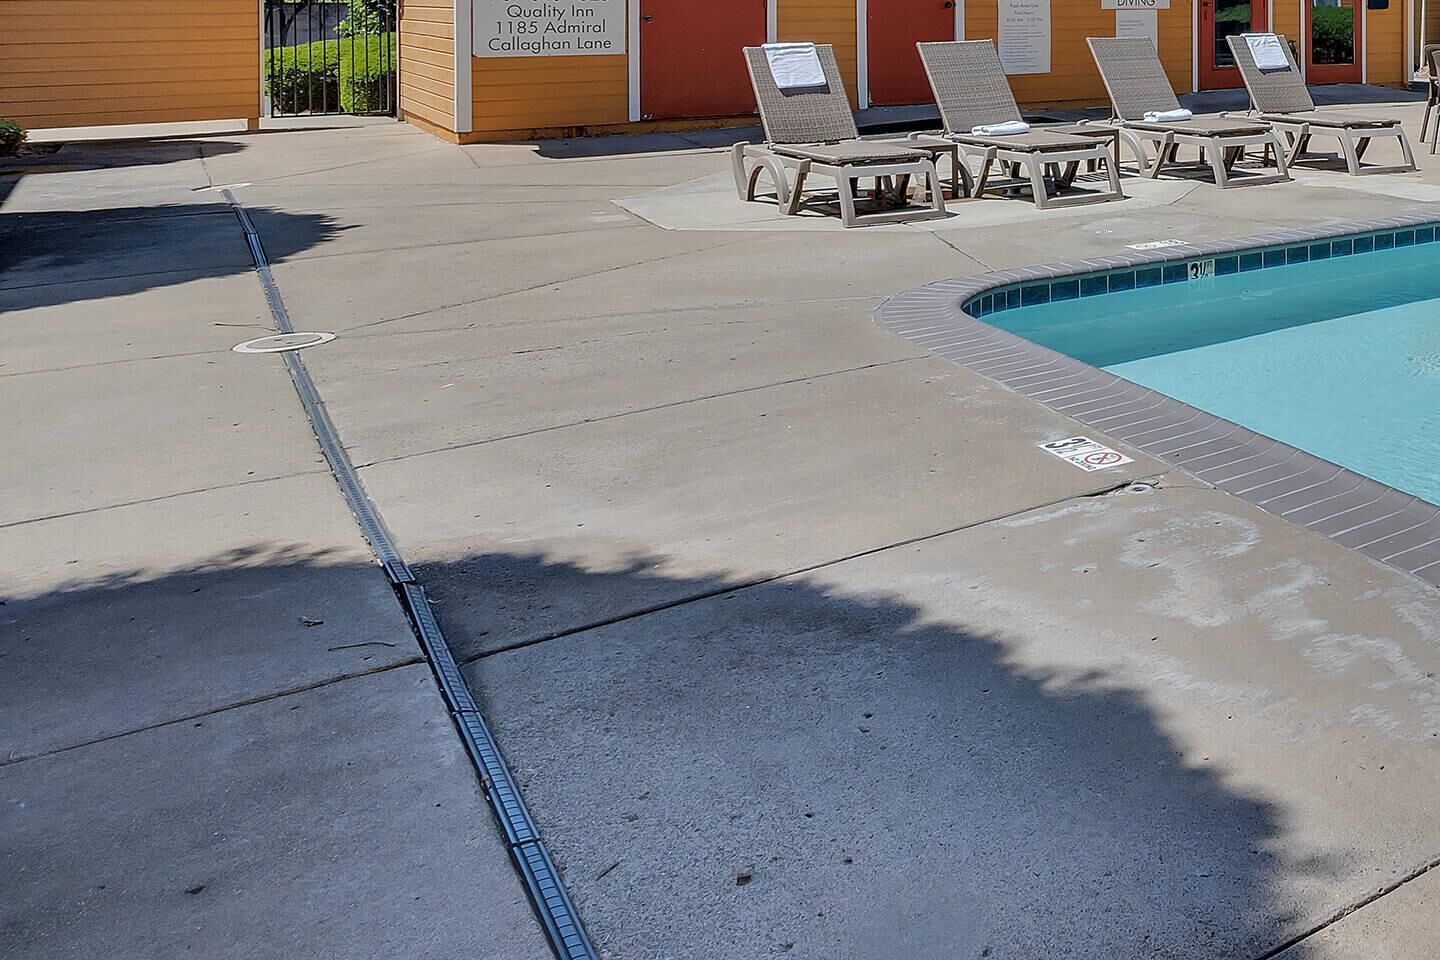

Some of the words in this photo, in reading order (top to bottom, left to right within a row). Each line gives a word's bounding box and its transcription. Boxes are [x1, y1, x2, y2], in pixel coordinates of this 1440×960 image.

[507, 4, 565, 21] Quality
[572, 4, 594, 17] Inn
[496, 21, 538, 34] 1185
[544, 20, 606, 34] Admiral
[488, 37, 570, 54] Callaghan
[577, 38, 611, 50] Lane
